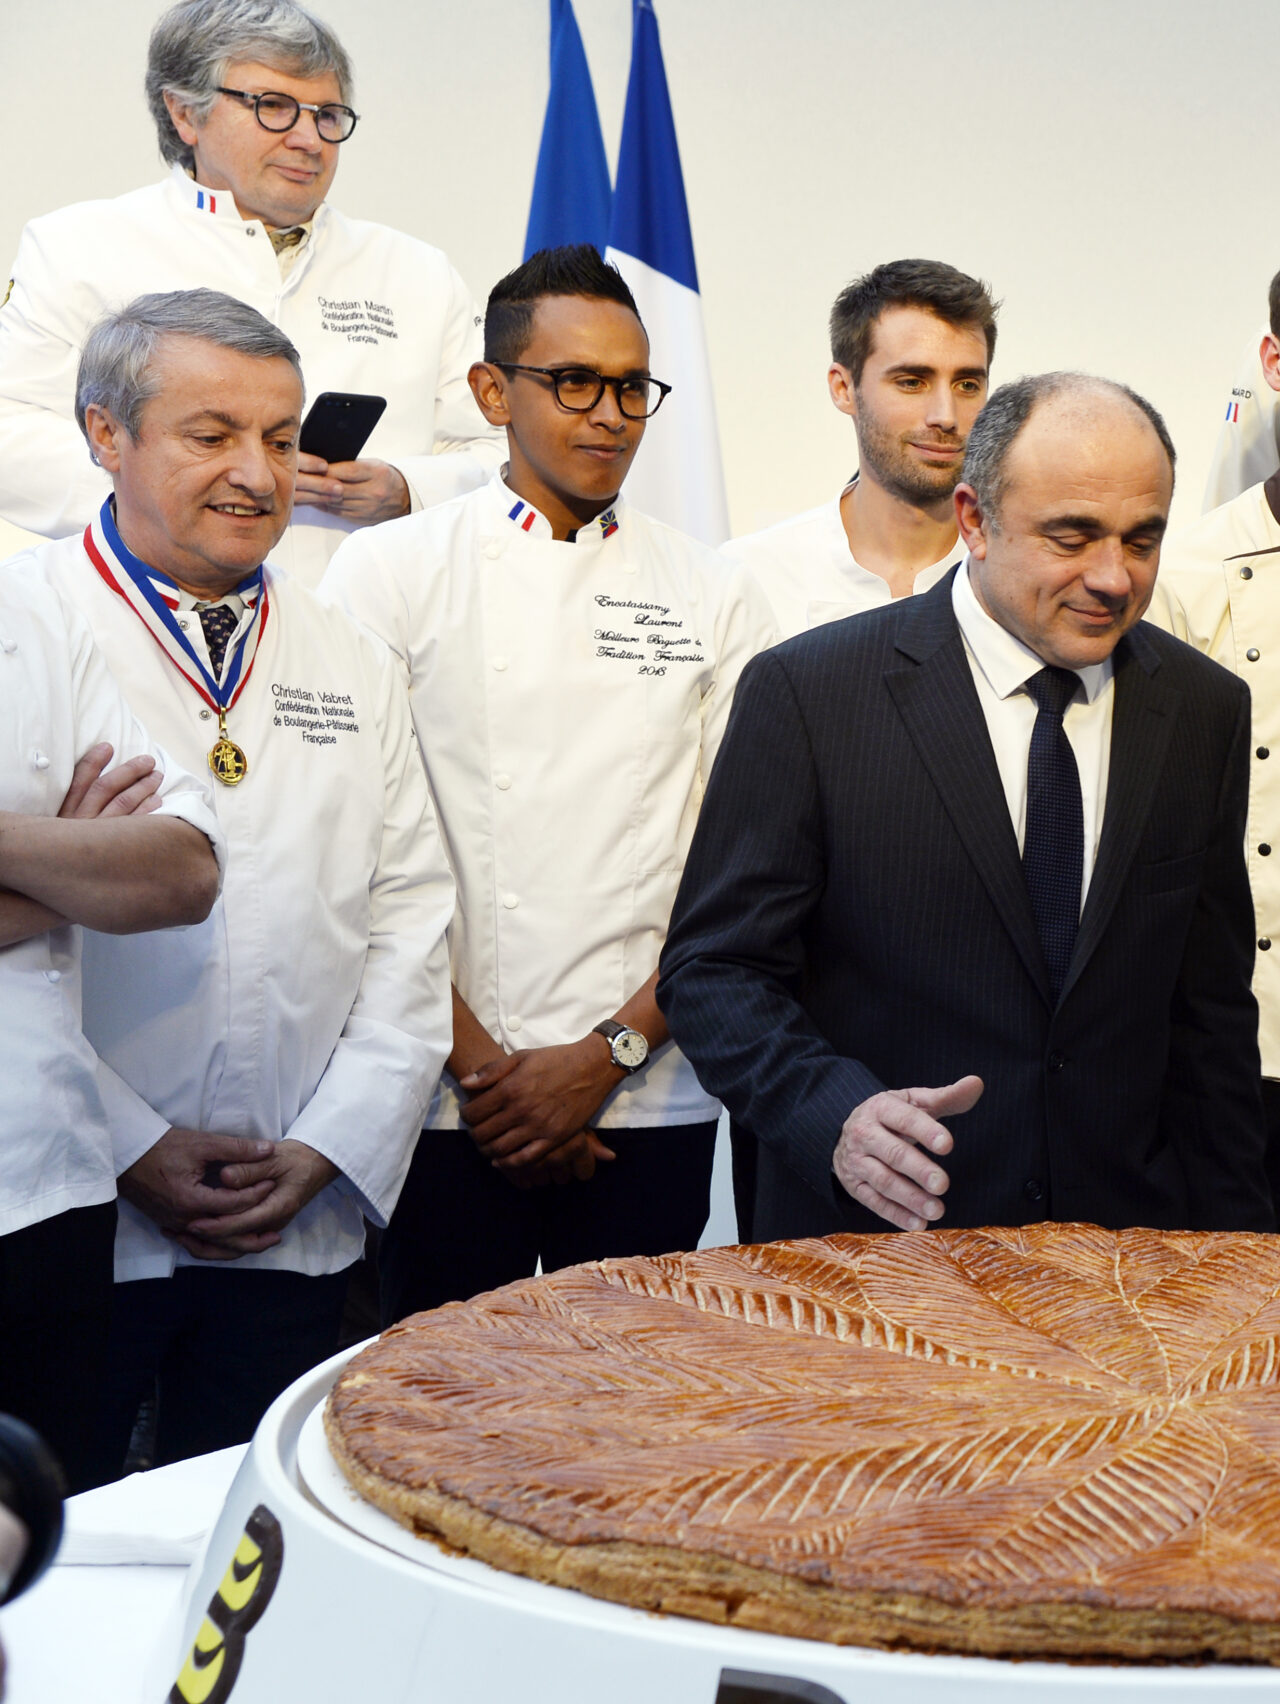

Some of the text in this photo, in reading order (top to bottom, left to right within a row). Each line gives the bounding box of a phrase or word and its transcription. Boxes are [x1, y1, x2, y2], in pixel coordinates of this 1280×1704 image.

[318, 296, 394, 316] Christian Martin
[633, 612, 683, 628] Laurent
[646, 633, 692, 650] Baguette
[595, 645, 646, 661] Tradition
[637, 664, 668, 677] 2018
[271, 683, 354, 705] Christian Vabret
[321, 705, 355, 719] Nationale
[273, 714, 282, 727] de
[302, 731, 336, 746] Française
